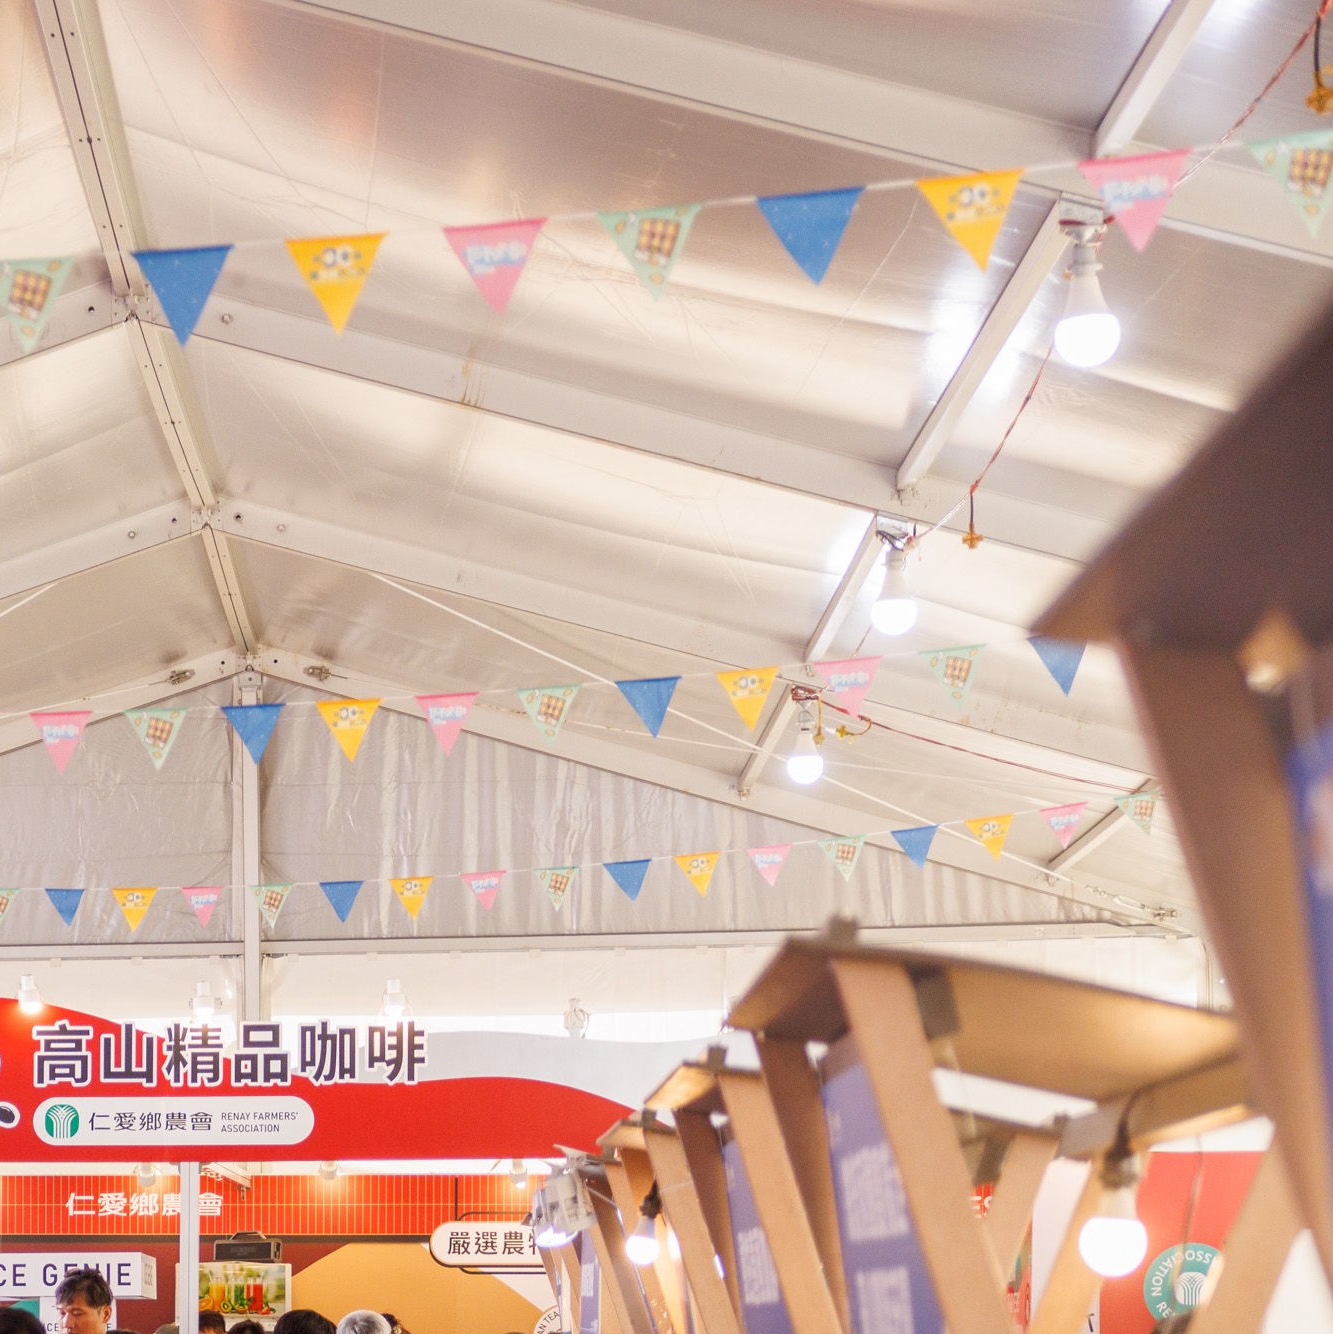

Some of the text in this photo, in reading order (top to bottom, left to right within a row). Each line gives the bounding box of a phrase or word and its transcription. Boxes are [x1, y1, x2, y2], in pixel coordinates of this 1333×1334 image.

[33, 1020, 427, 1087] 高山精品咖啡
[88, 1111, 213, 1133] 仁愛鄉農會
[221, 1111, 299, 1121] RENAY FARMERS'
[221, 1124, 280, 1133] ASSOCIATION
